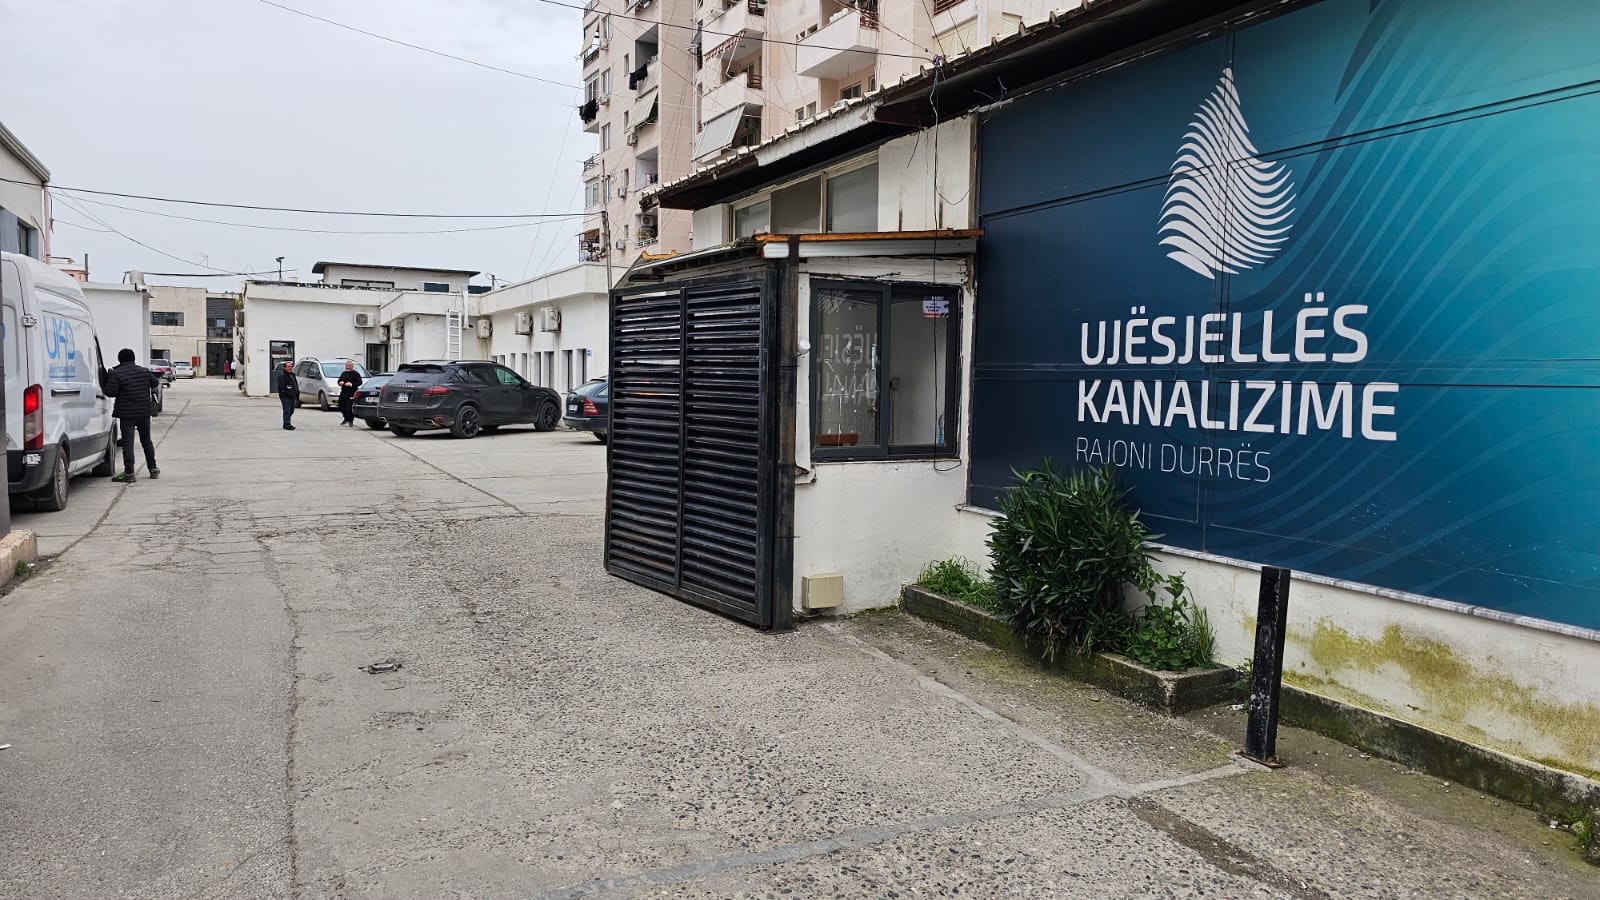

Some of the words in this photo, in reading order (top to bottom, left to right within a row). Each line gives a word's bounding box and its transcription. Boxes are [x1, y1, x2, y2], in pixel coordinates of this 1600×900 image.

[1081, 292, 1368, 365] UJËSJELLËS
[1077, 379, 1399, 441] KANALIZIME
[1076, 437, 1152, 469] RAJONI
[1161, 443, 1271, 483] DURRËS
